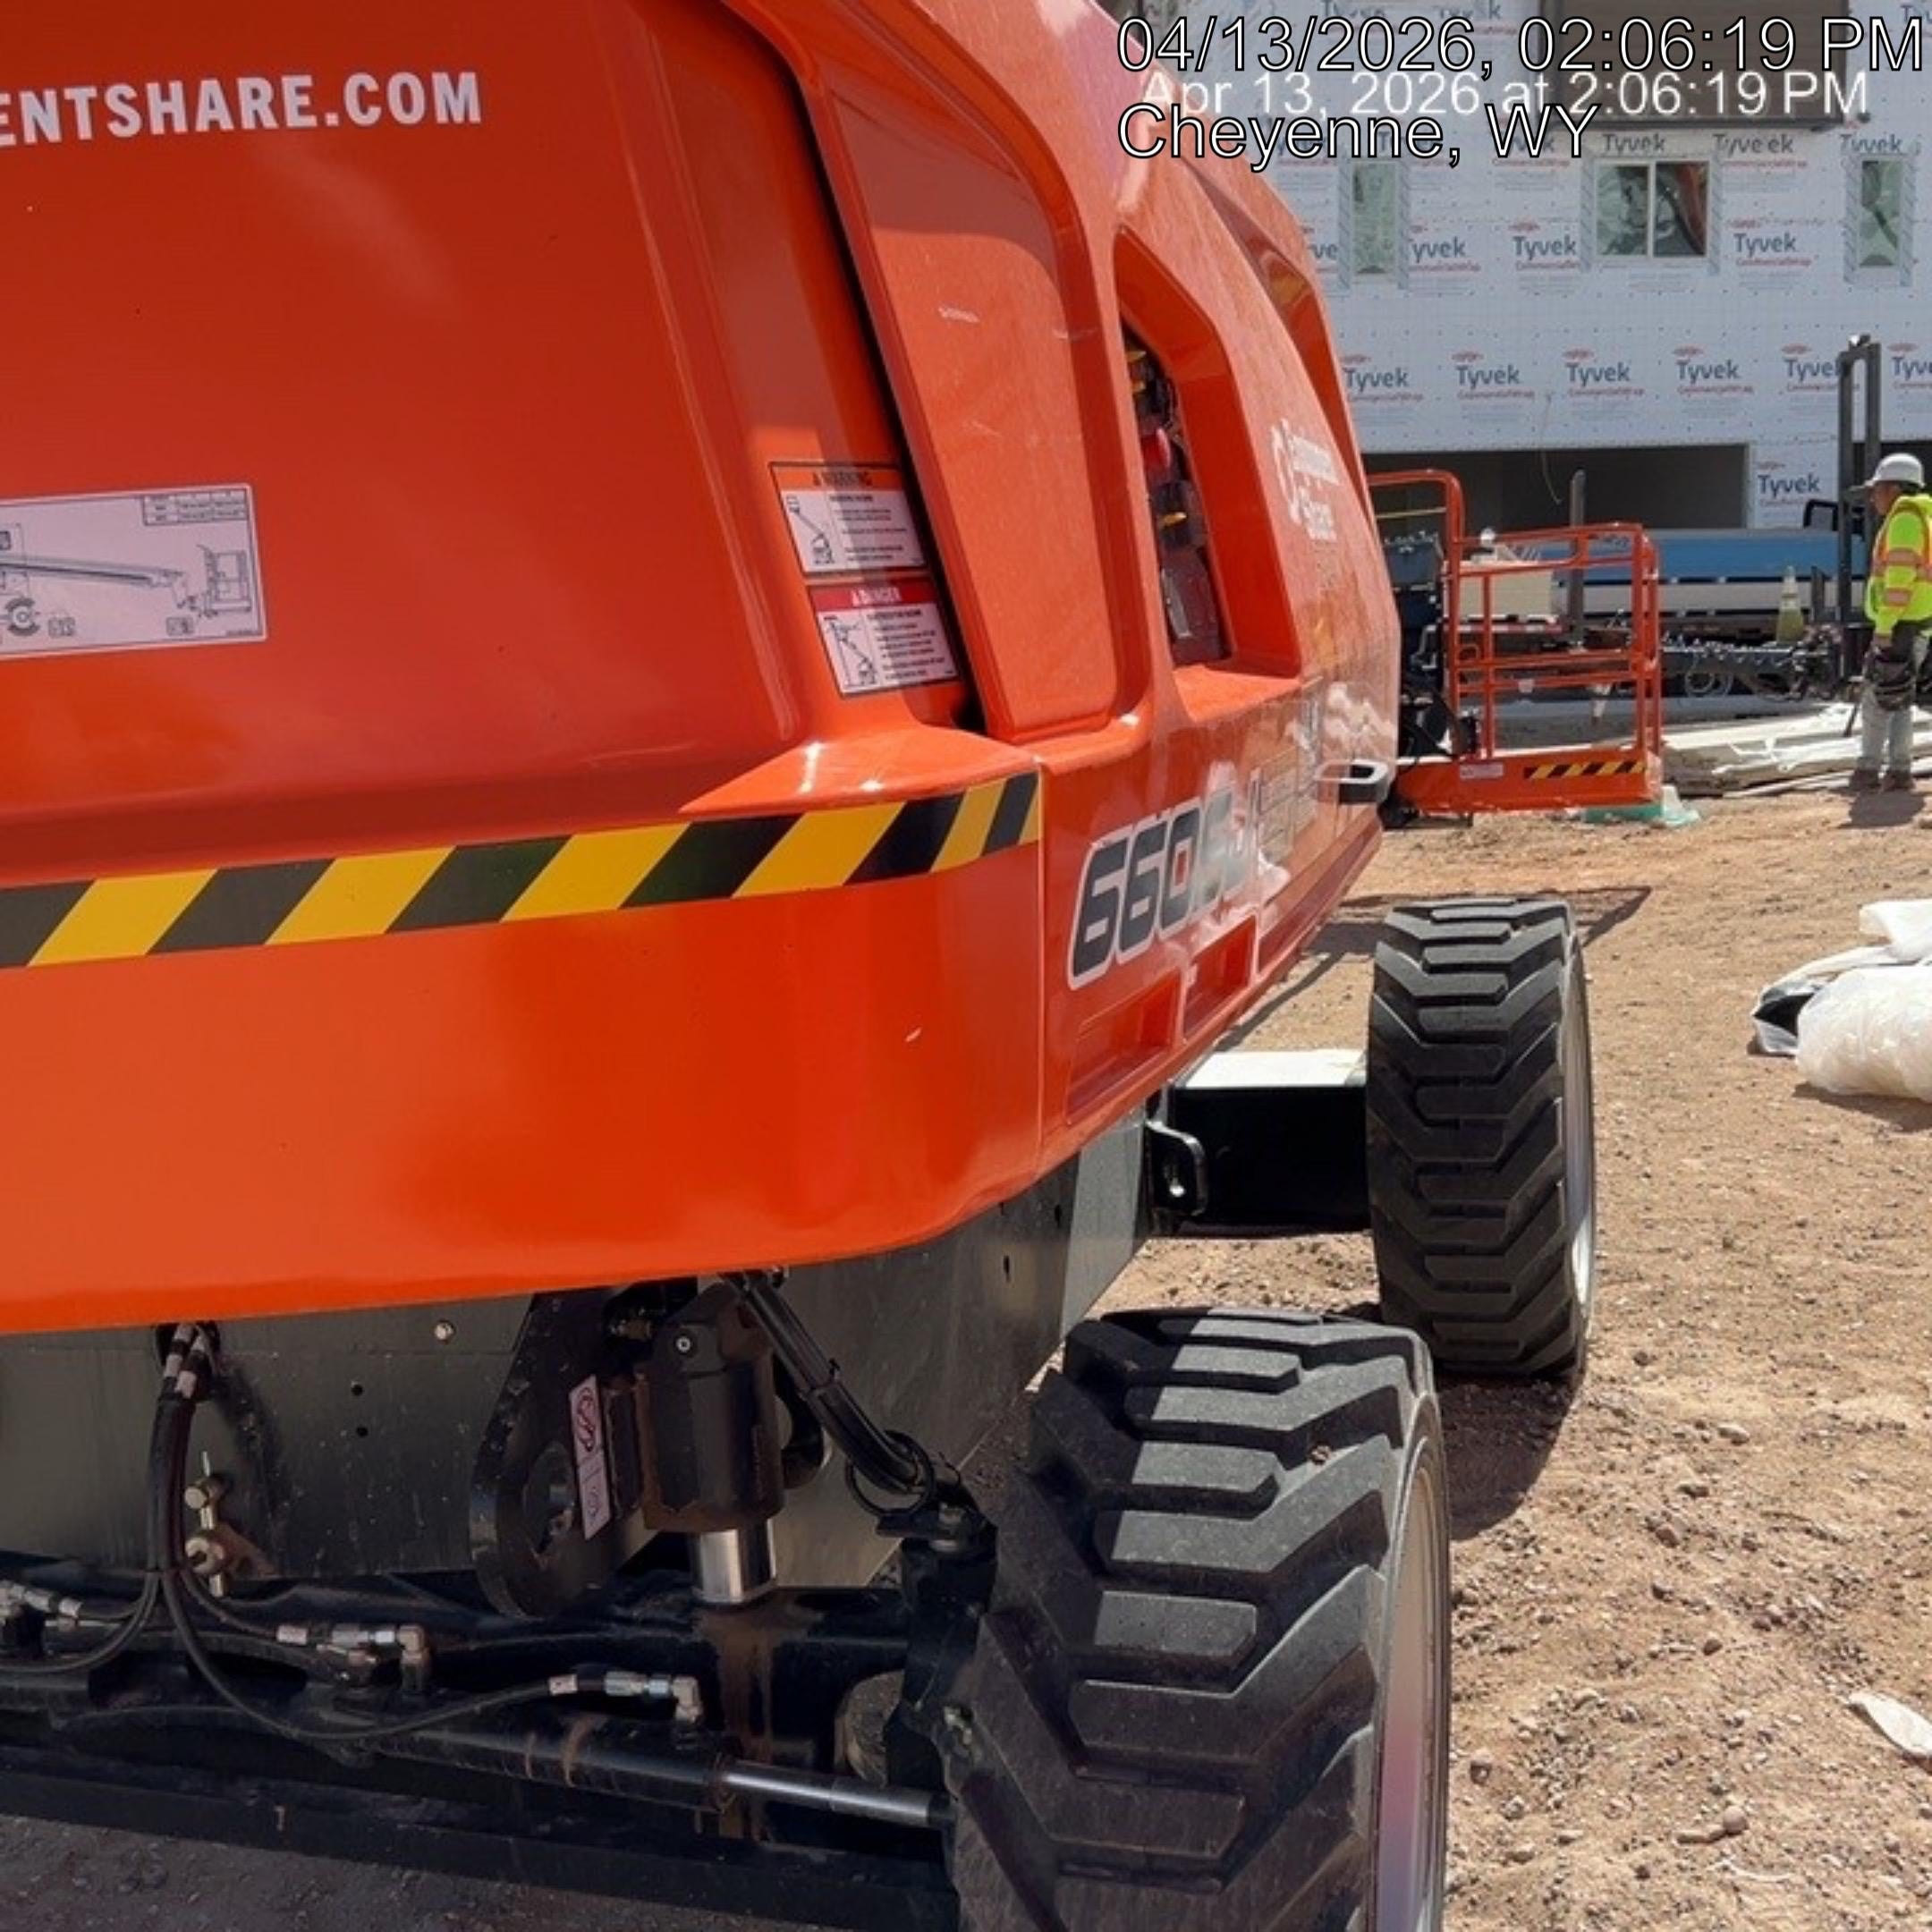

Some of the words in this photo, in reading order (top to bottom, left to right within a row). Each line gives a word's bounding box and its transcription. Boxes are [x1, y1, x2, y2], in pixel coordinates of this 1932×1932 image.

[1409, 235, 1467, 264] yvek
[1513, 233, 1578, 261] Tyvek
[1733, 232, 1797, 257] Tyvek
[1342, 366, 1410, 393] Tyvek
[1455, 364, 1521, 390] Tyvek
[1566, 361, 1631, 387] Tyvek
[1676, 359, 1741, 385] Tyvek
[1785, 357, 1842, 382] Tyve
[1893, 356, 1932, 381] Tyv
[1757, 473, 1821, 498] Tyvek
